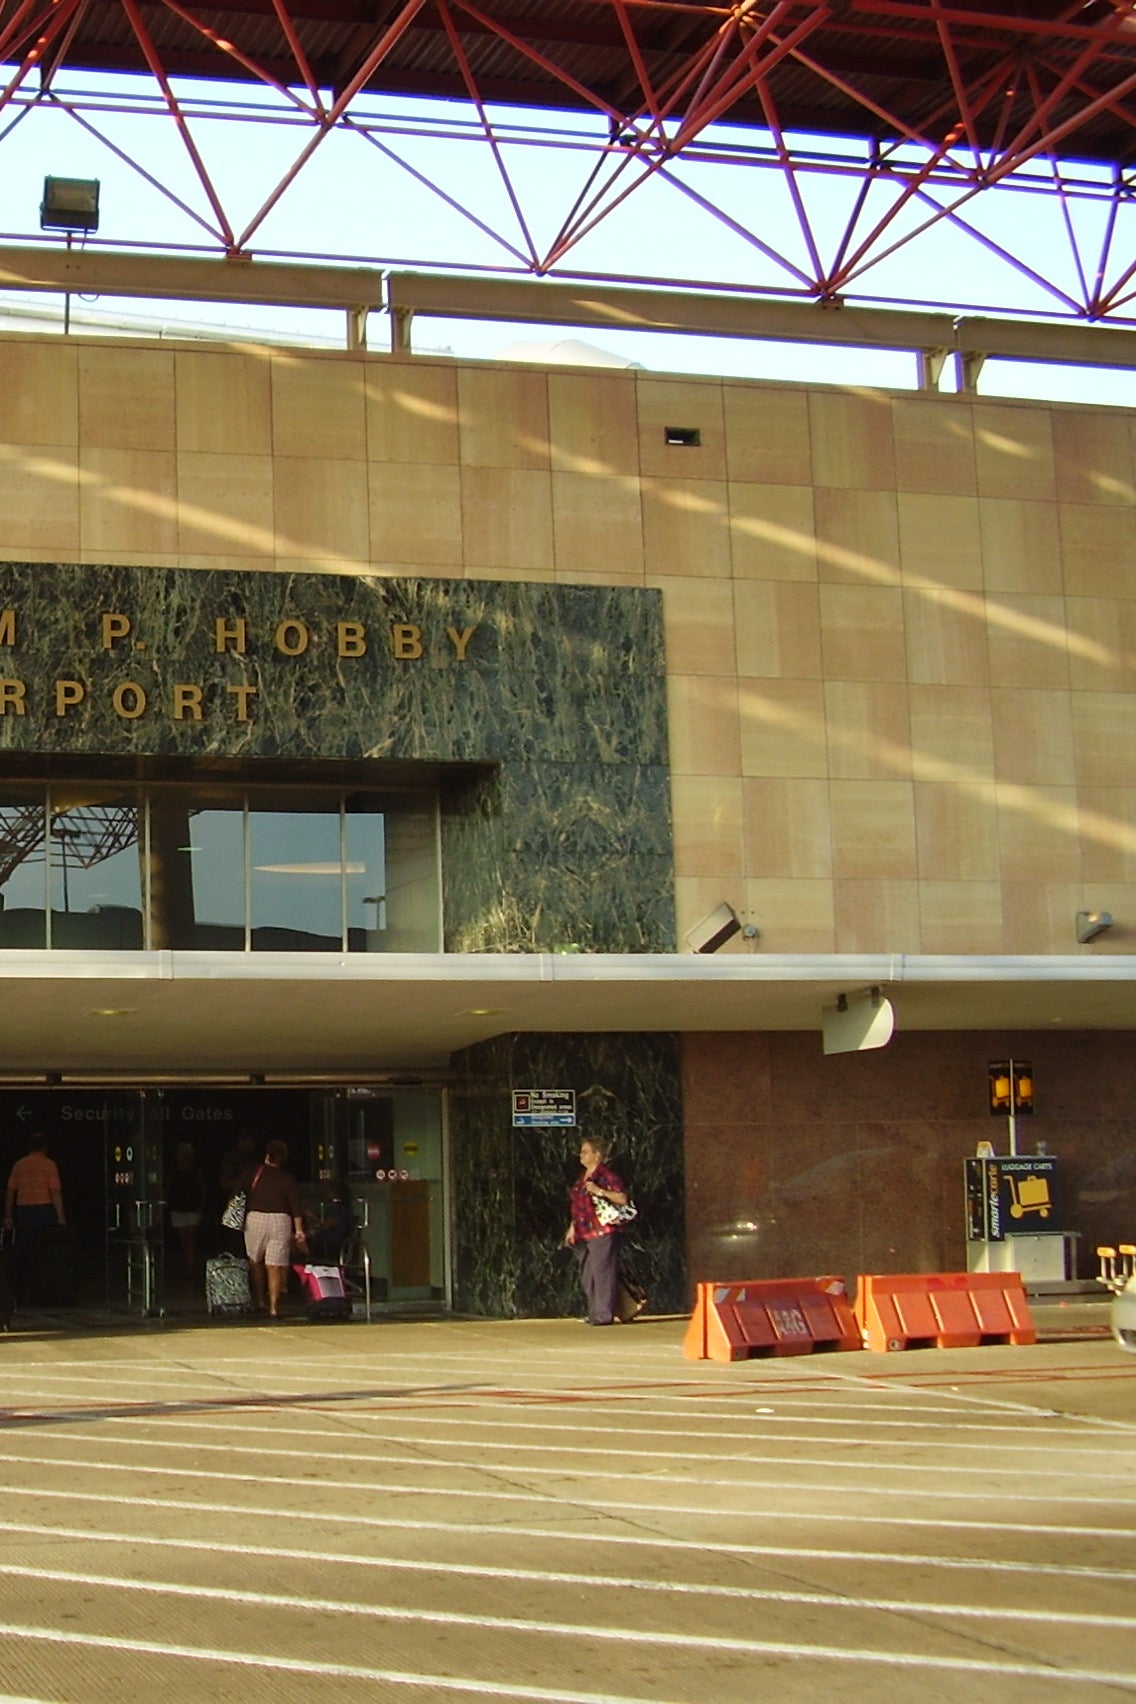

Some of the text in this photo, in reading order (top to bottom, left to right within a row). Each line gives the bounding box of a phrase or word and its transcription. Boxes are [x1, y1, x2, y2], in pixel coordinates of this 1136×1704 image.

[101, 613, 147, 650] P.
[215, 617, 477, 662] HOBBY
[181, 1105, 234, 1121] Gates
[1001, 1162, 1032, 1171] LUGGAGE
